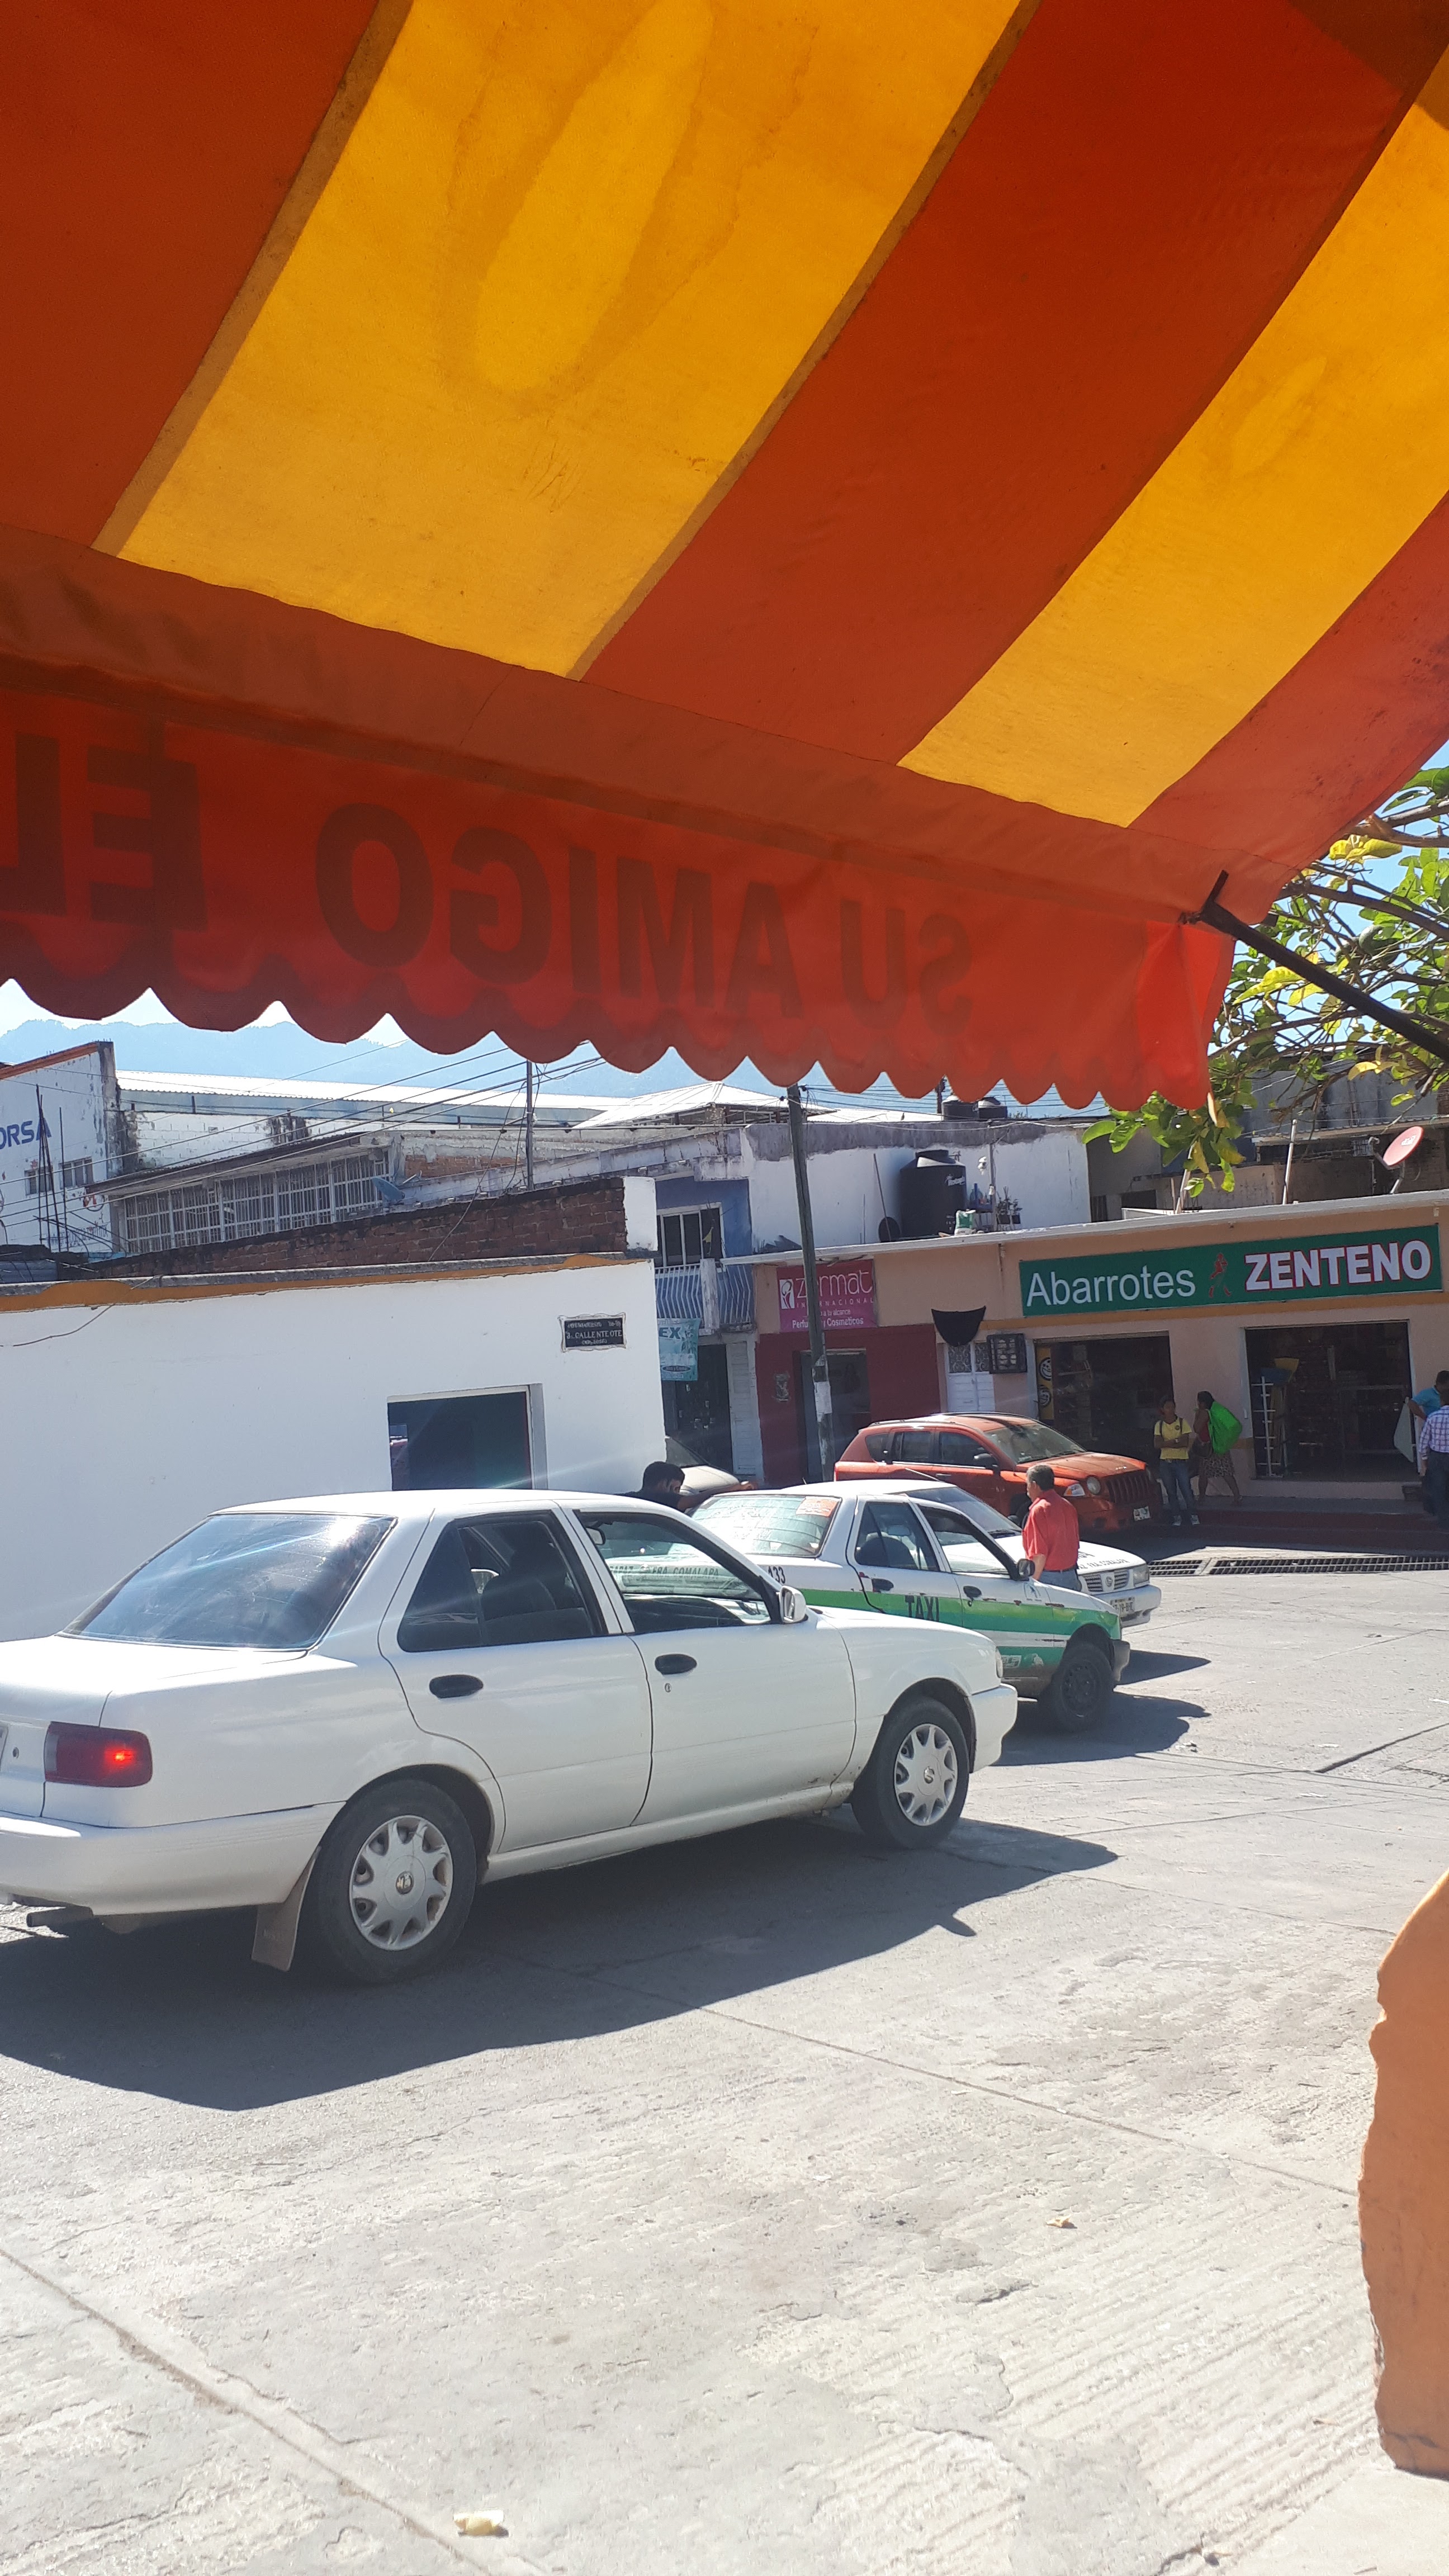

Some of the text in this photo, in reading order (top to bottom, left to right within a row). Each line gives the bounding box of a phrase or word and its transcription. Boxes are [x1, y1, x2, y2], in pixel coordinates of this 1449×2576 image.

[1026, 1239, 1432, 1306] Abarrotes ZENTENO
[797, 1298, 874, 1308] INRNACIONAL
[905, 1595, 939, 1621] TAXI
